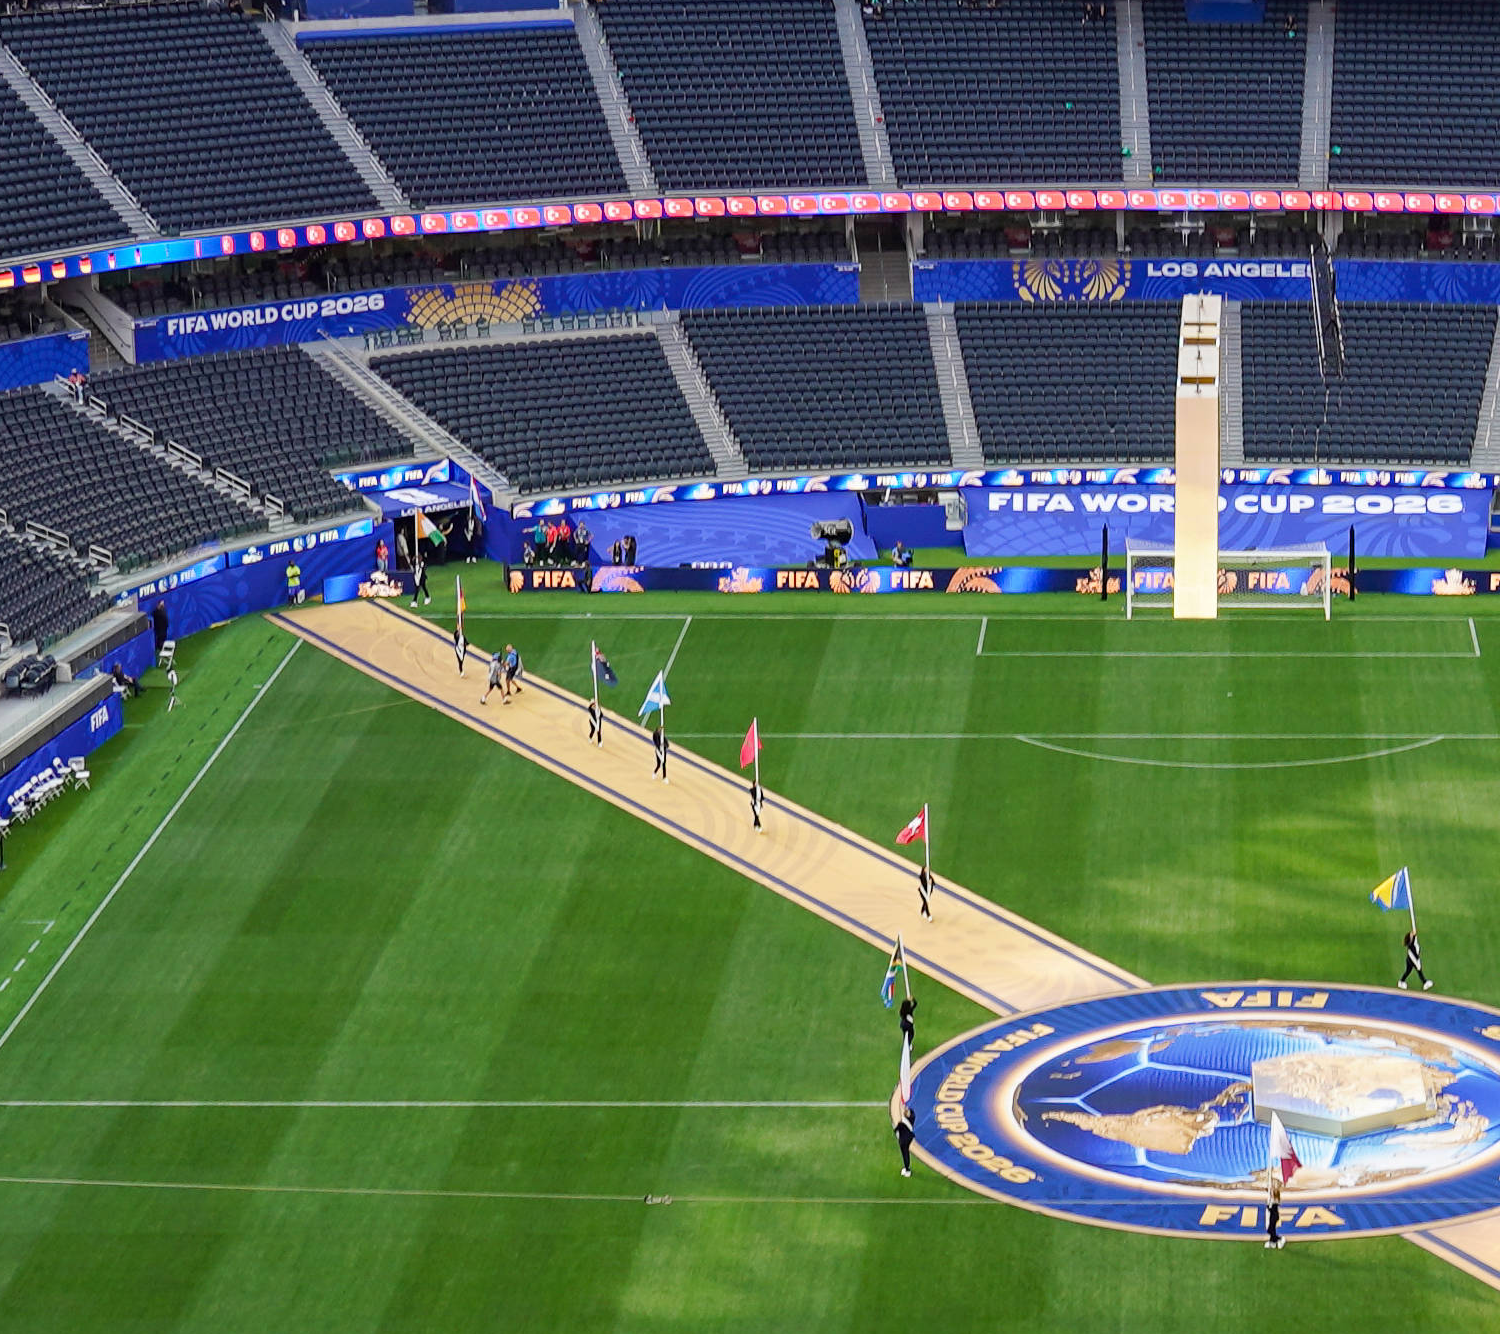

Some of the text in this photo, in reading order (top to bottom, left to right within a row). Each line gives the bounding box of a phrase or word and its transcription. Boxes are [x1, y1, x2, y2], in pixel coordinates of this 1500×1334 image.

[1148, 263, 1198, 277] LOS
[168, 294, 384, 335] FIFA WORLD CUP 2026
[989, 493, 1074, 511] FIFA
[1235, 495, 1314, 513] CUP
[1322, 495, 1462, 514] 2026
[533, 571, 575, 587] FIFA
[777, 571, 819, 588] FIFA
[890, 571, 933, 588] FIFA
[1249, 572, 1290, 589] FIFA
[91, 706, 108, 732] FIFA
[1200, 991, 1330, 1008] FIFA
